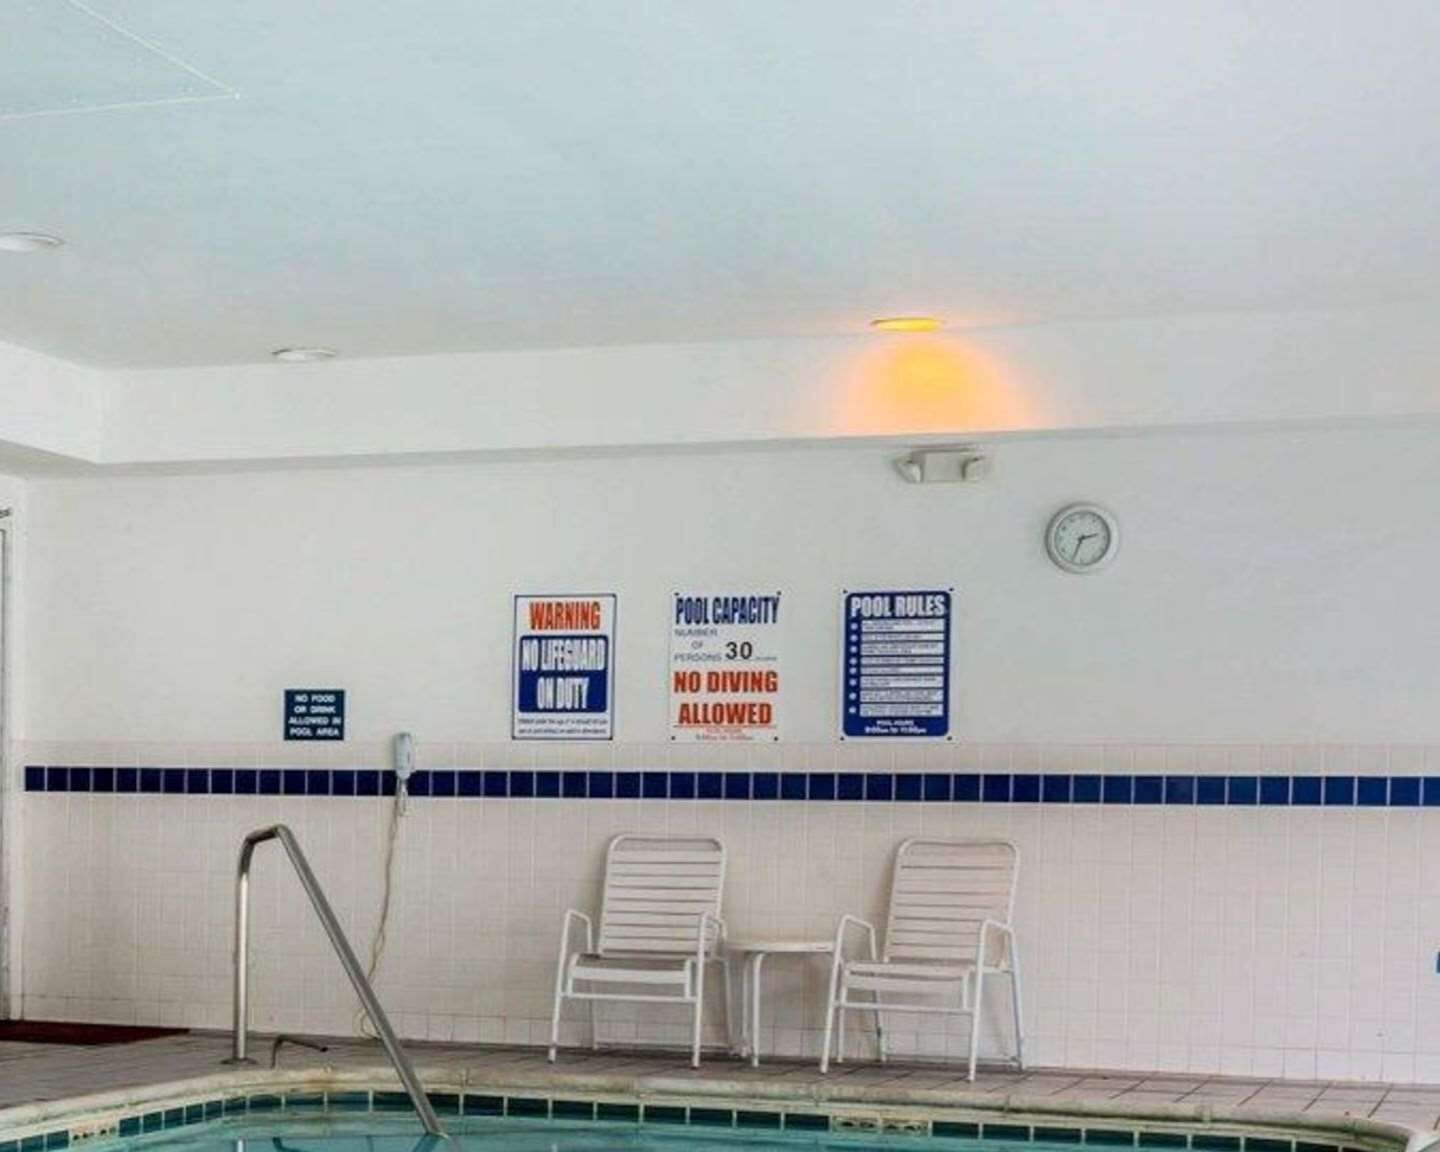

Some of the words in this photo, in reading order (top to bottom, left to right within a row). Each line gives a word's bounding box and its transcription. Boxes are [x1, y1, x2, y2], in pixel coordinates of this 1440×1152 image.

[530, 601, 601, 630] WARNING
[676, 597, 709, 624] POOL
[712, 596, 780, 624] CAPACITY
[851, 597, 892, 617] POOL
[895, 596, 945, 617] RULES
[674, 628, 718, 637] NUMBER
[522, 639, 539, 671] NO
[541, 639, 605, 671] LIFEGUARD
[725, 641, 753, 660] 30
[674, 671, 701, 693] NO
[707, 671, 778, 693] DIVING
[294, 694, 309, 703] NO
[311, 694, 336, 703] FOOD
[537, 677, 554, 709] ON
[556, 677, 589, 709] DUTY
[288, 716, 330, 726] ALLOWED
[679, 703, 772, 725] ALLOWED
[289, 727, 313, 737] POOL
[316, 727, 340, 737] AREA
